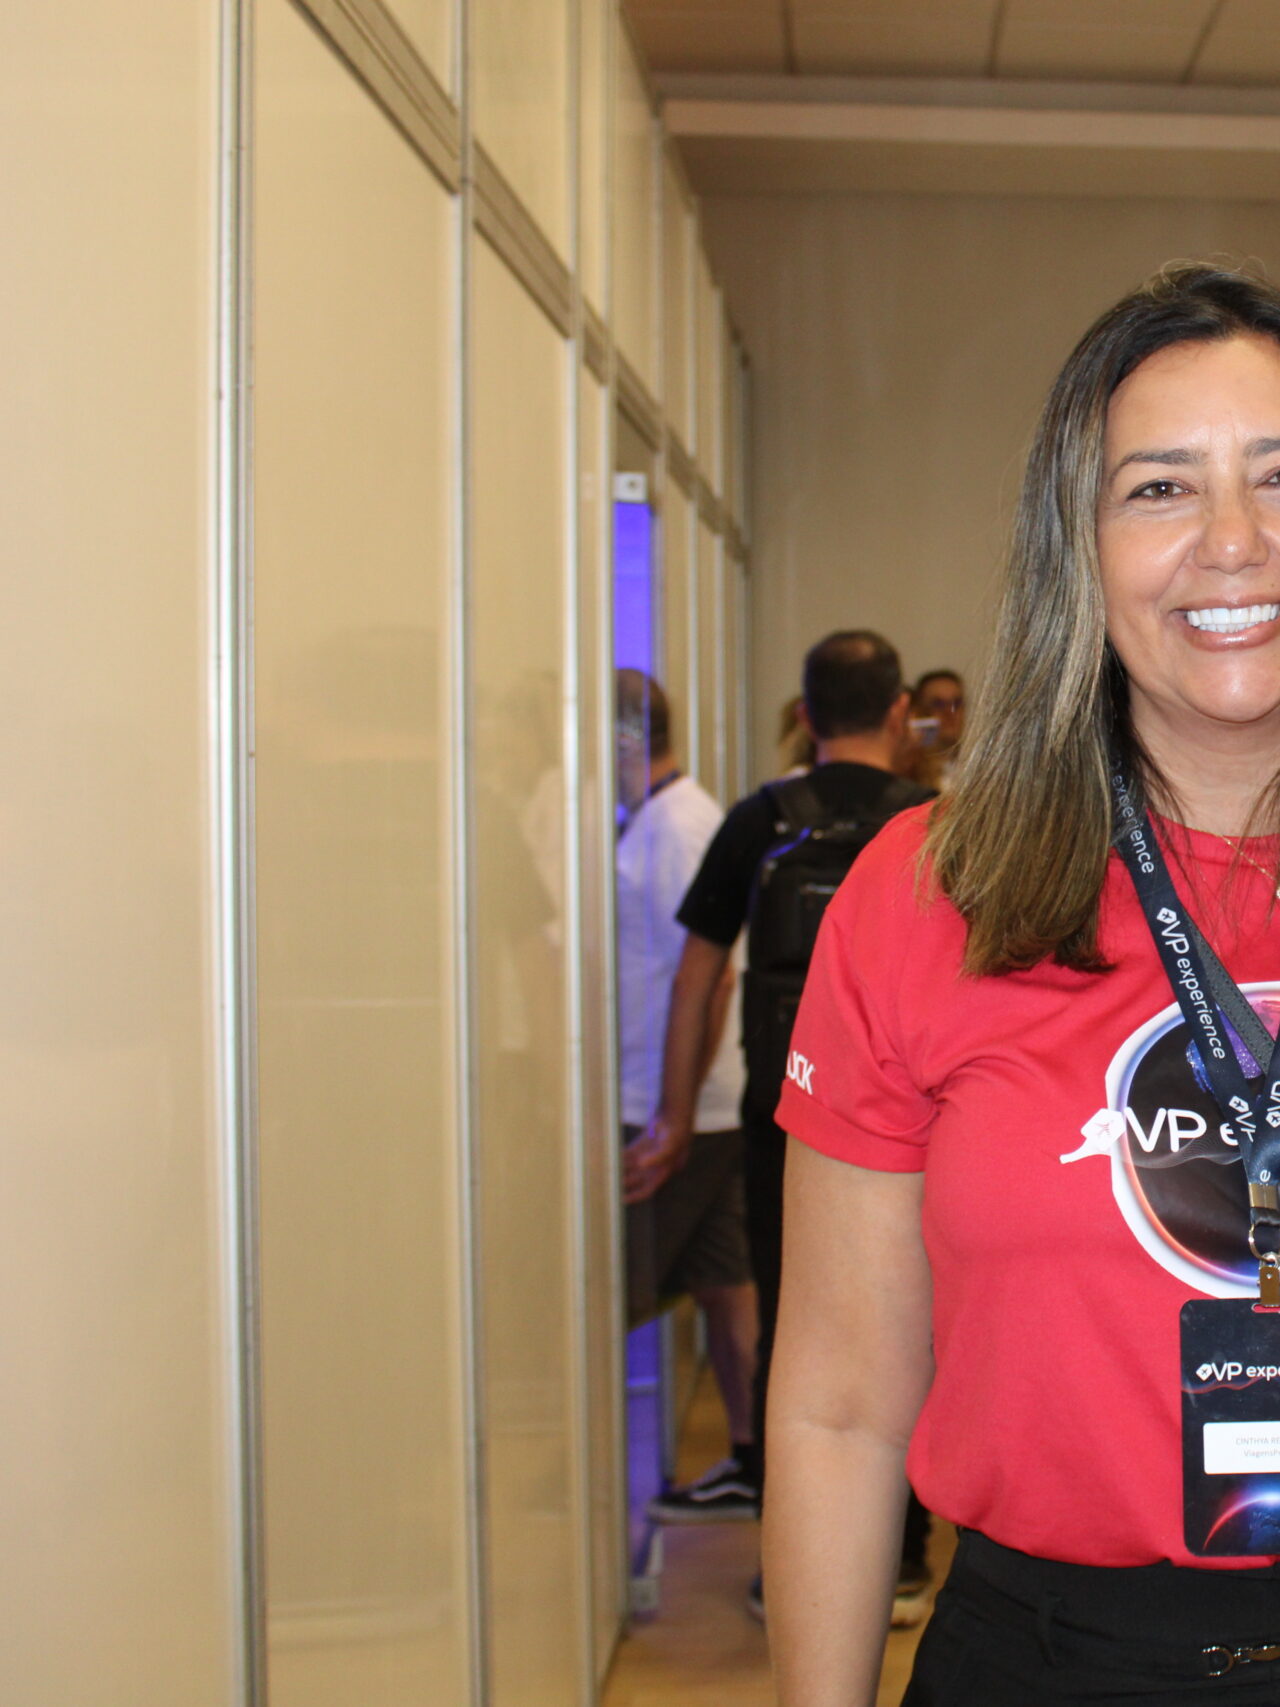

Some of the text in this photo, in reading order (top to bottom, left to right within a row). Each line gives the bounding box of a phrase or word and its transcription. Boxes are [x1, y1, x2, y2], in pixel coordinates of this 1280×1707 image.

[1161, 920, 1226, 1060] VP experience
[1124, 1107, 1208, 1153] VP
[1211, 1362, 1243, 1381] VP
